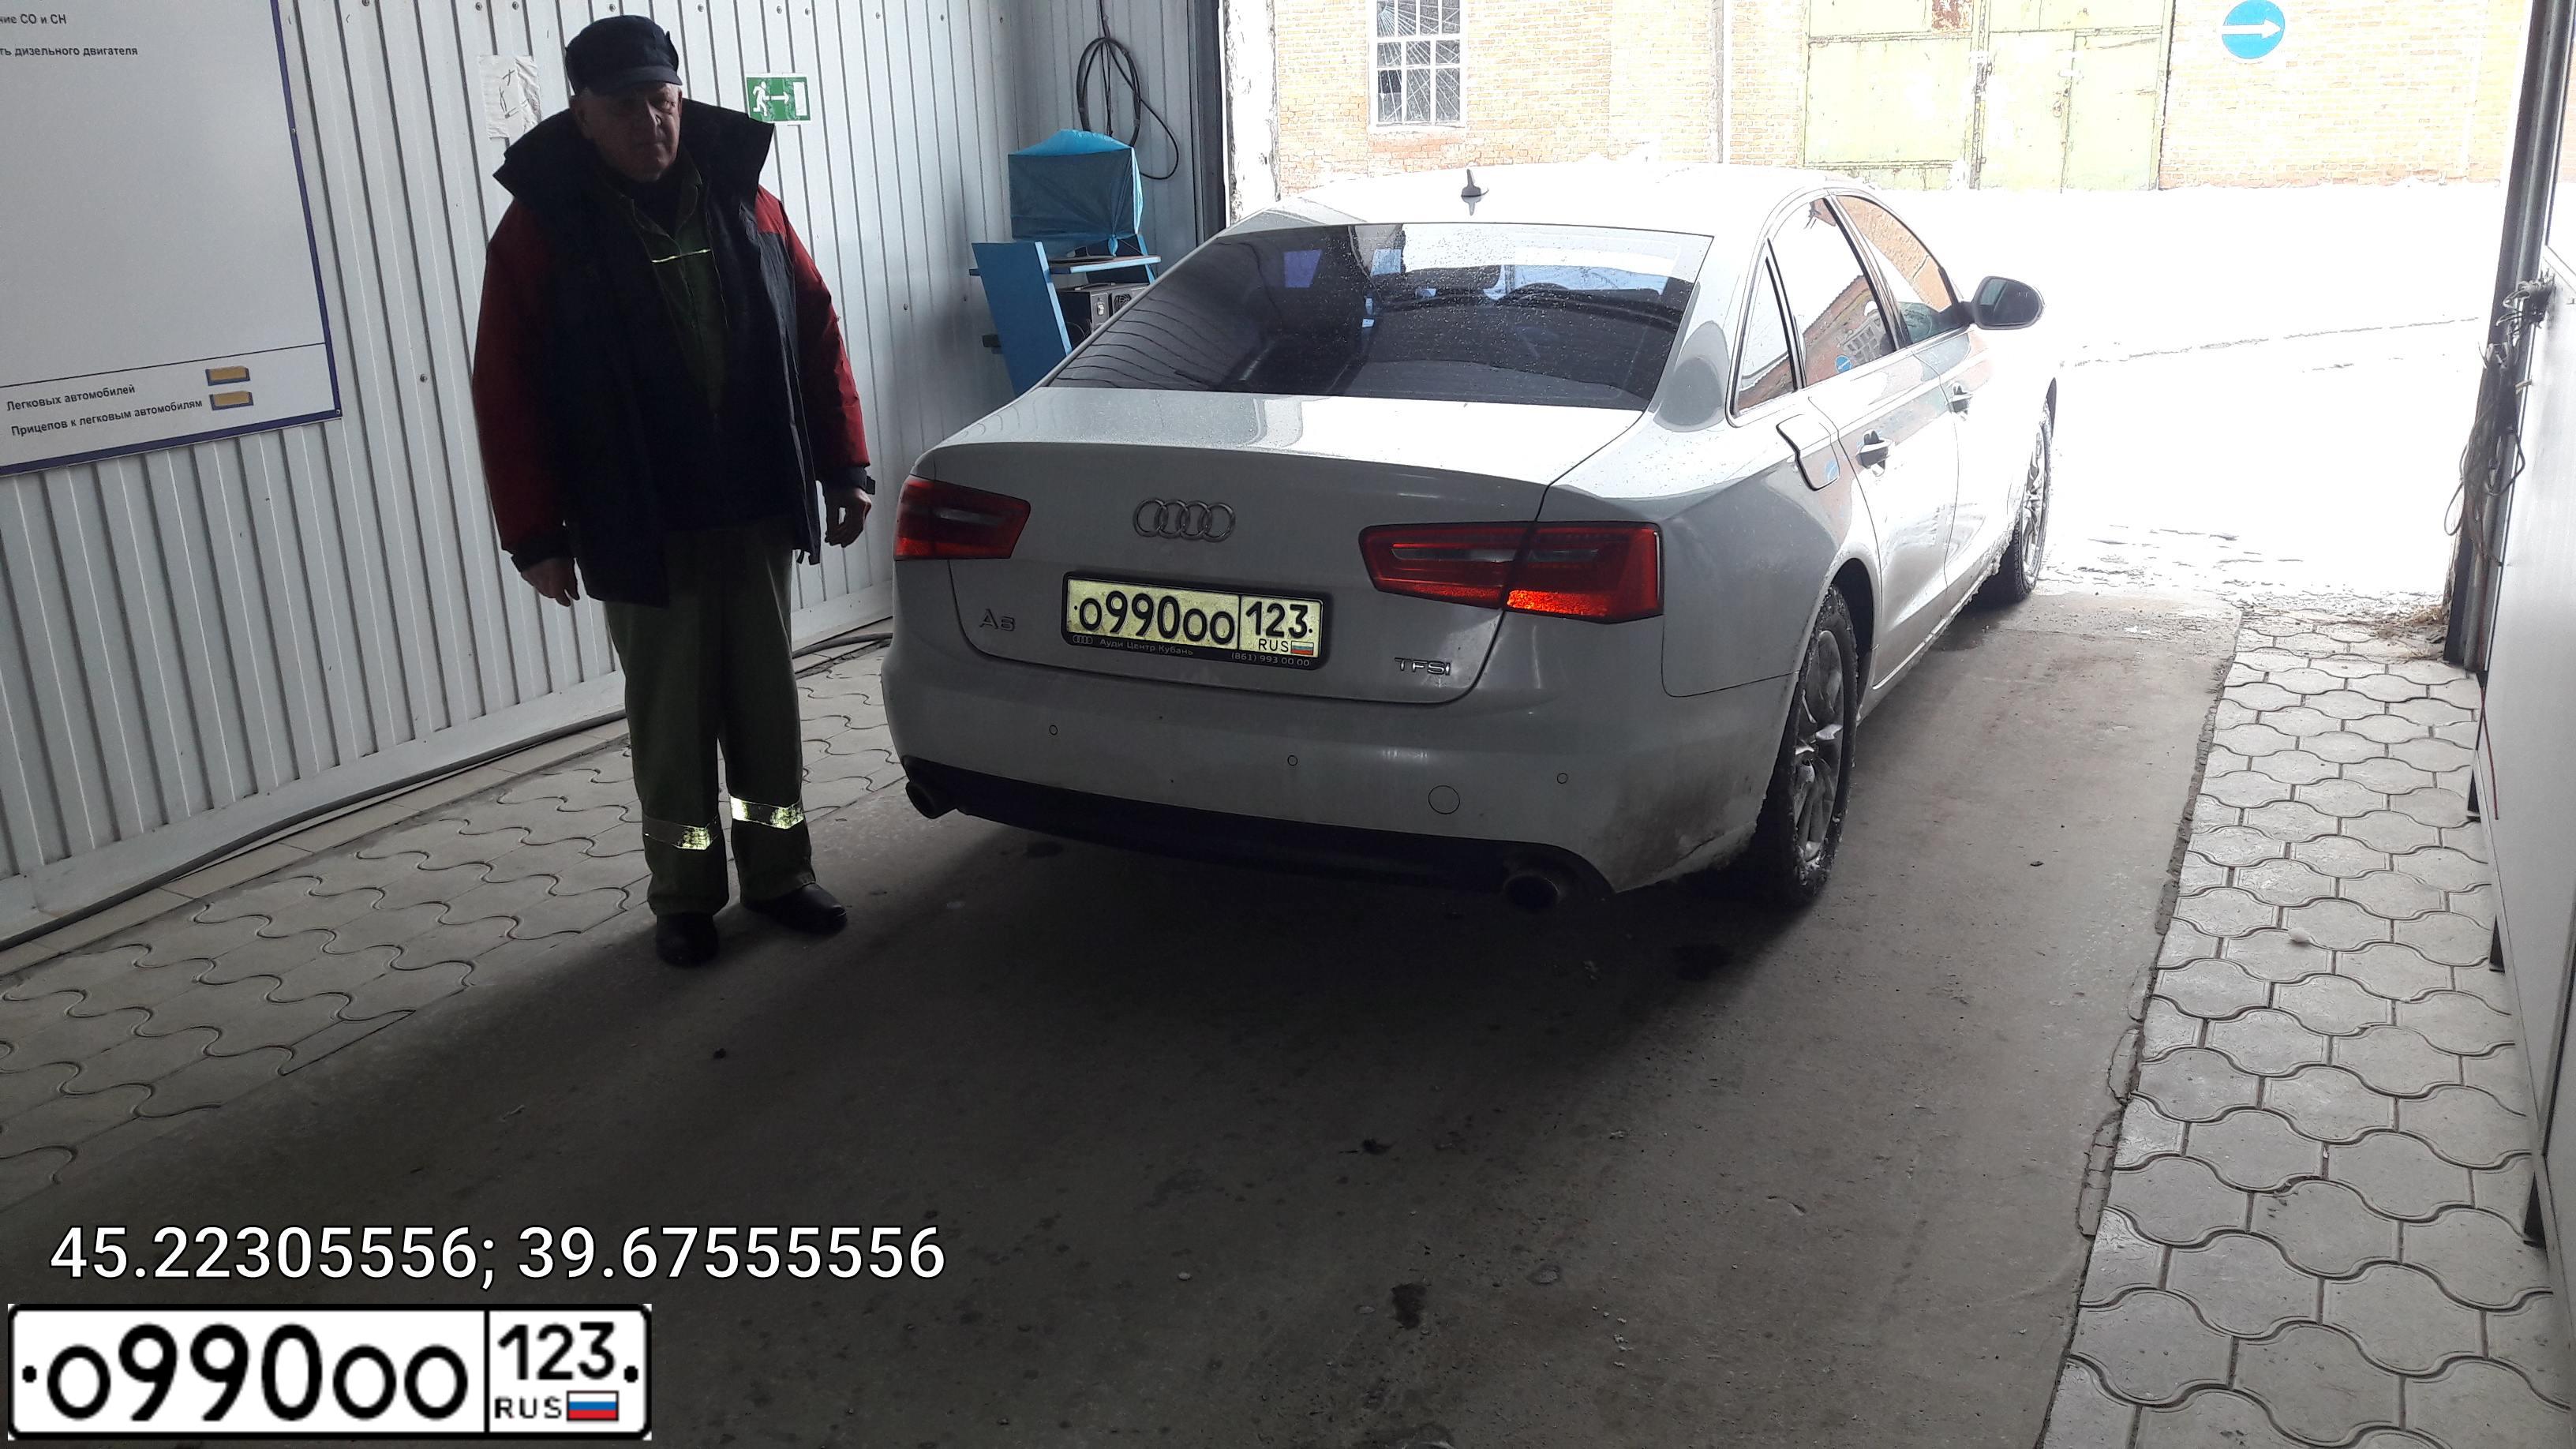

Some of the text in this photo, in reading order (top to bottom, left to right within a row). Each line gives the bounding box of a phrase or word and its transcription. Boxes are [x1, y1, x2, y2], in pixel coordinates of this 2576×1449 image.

[15, 47, 80, 57] дизельного
[83, 47, 138, 57] двигателя
[7, 384, 136, 411] Легковых автомобилей
[11, 419, 68, 437] Прицепов
[80, 410, 132, 426] легковым
[134, 399, 203, 417] автомобилям
[1245, 601, 1308, 638] 123
[1099, 638, 1194, 656] Ауди Центр Кубань
[1258, 638, 1289, 652] RUS
[1231, 652, 1257, 662] (861)
[1260, 654, 1279, 664] 993
[1394, 657, 1451, 676] TFSI
